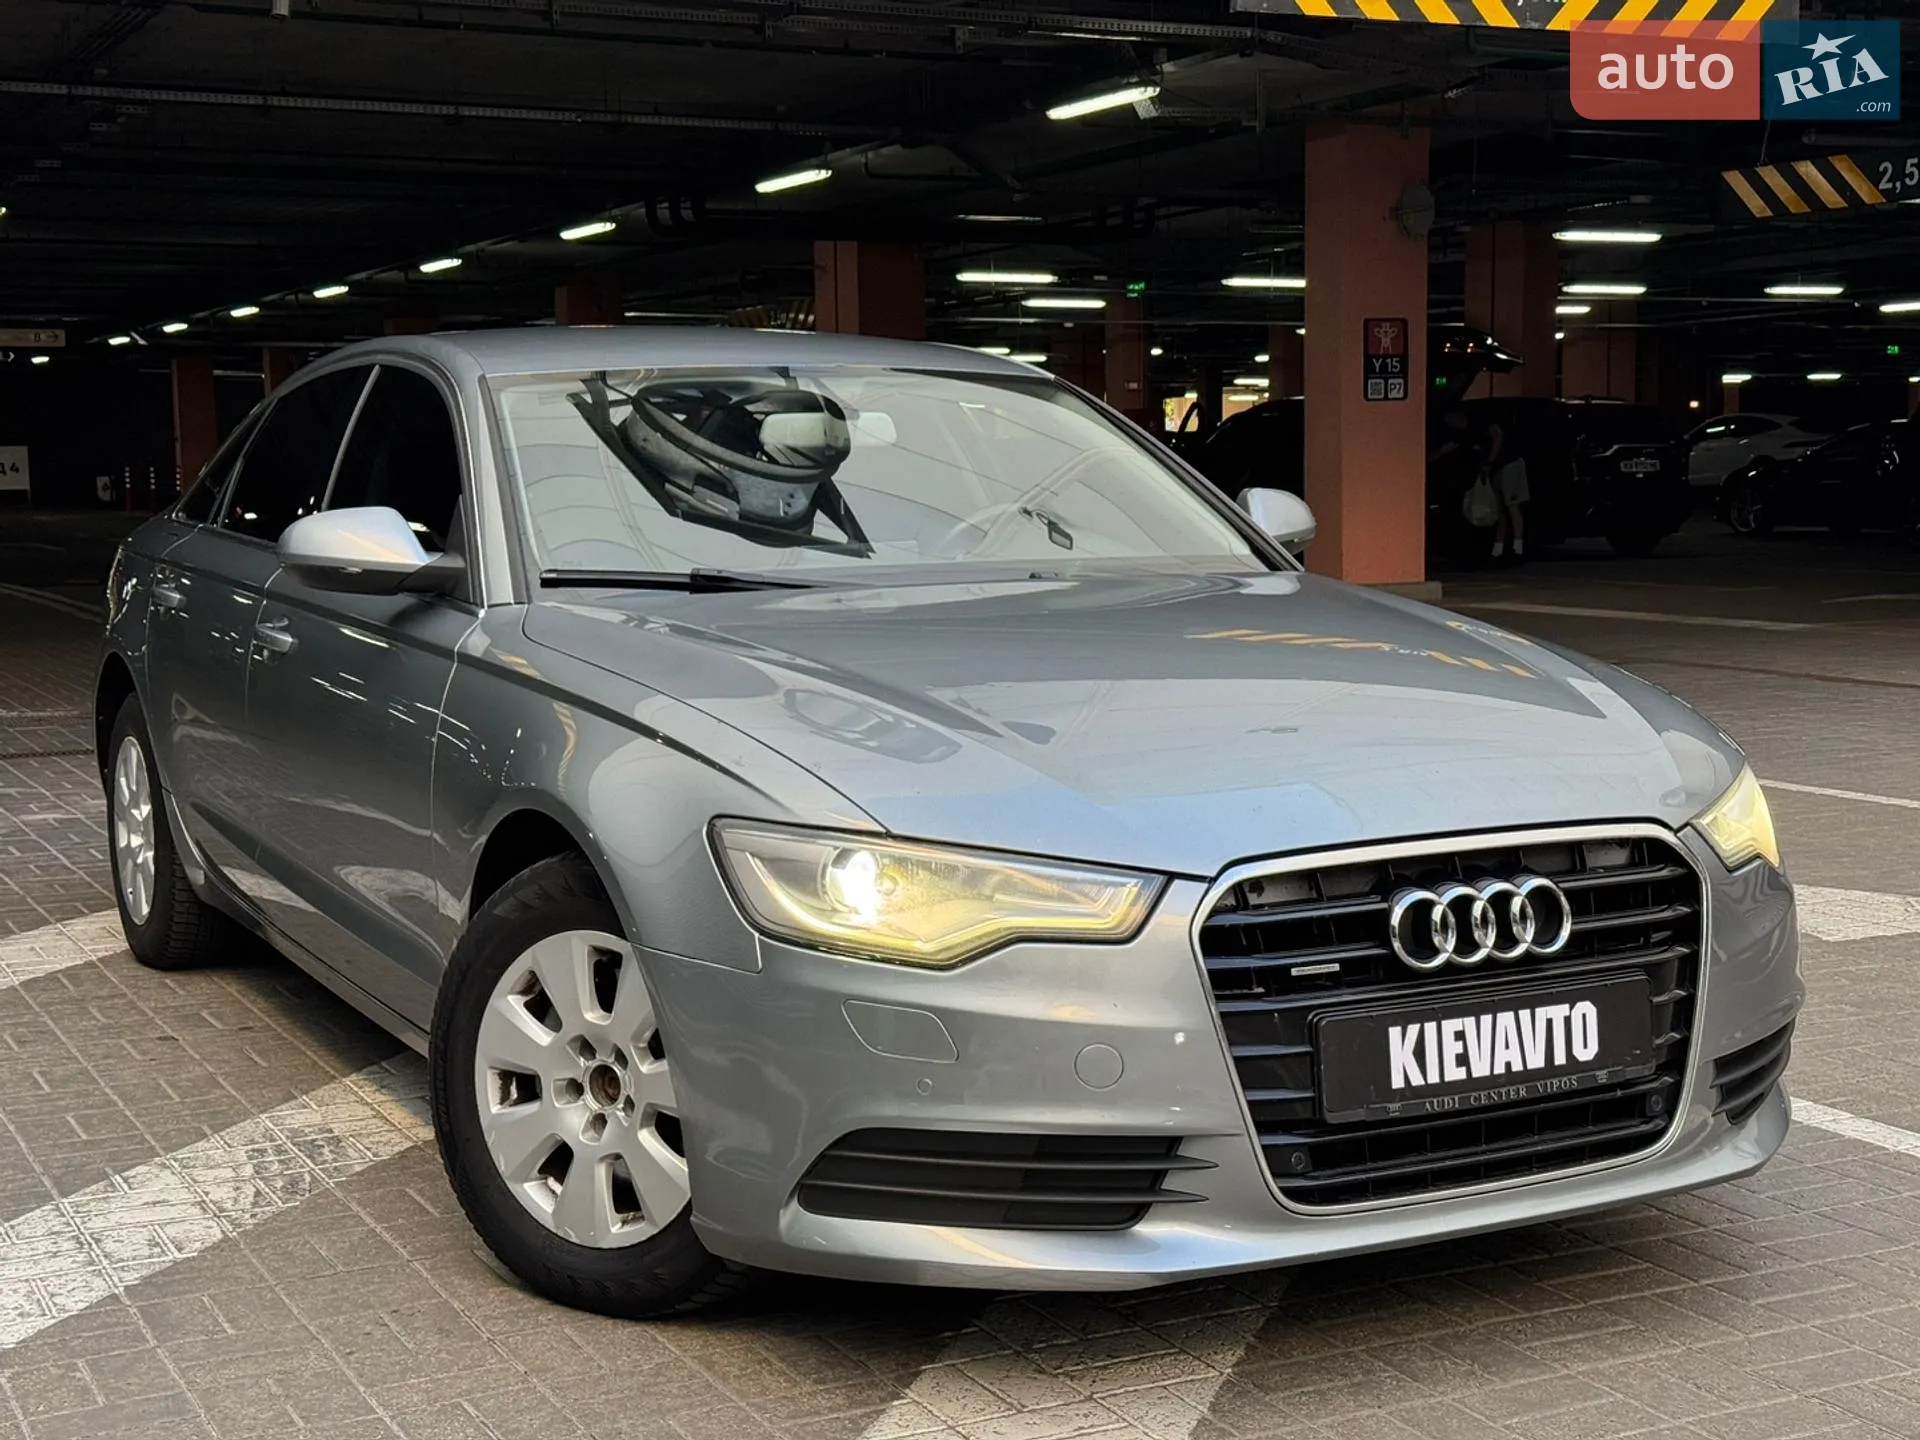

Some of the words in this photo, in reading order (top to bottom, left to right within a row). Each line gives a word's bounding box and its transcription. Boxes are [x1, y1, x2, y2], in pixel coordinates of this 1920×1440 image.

[1878, 157, 1920, 194] 2,5
[1372, 358, 1383, 373] Y
[1385, 358, 1400, 373] 15
[1389, 382, 1402, 395] P7
[1388, 1000, 1599, 1089] KIEVAVTO
[1423, 1098, 1459, 1113] AUDI
[1470, 1086, 1528, 1105] CENTER
[1536, 1076, 1578, 1094] VIPOS
